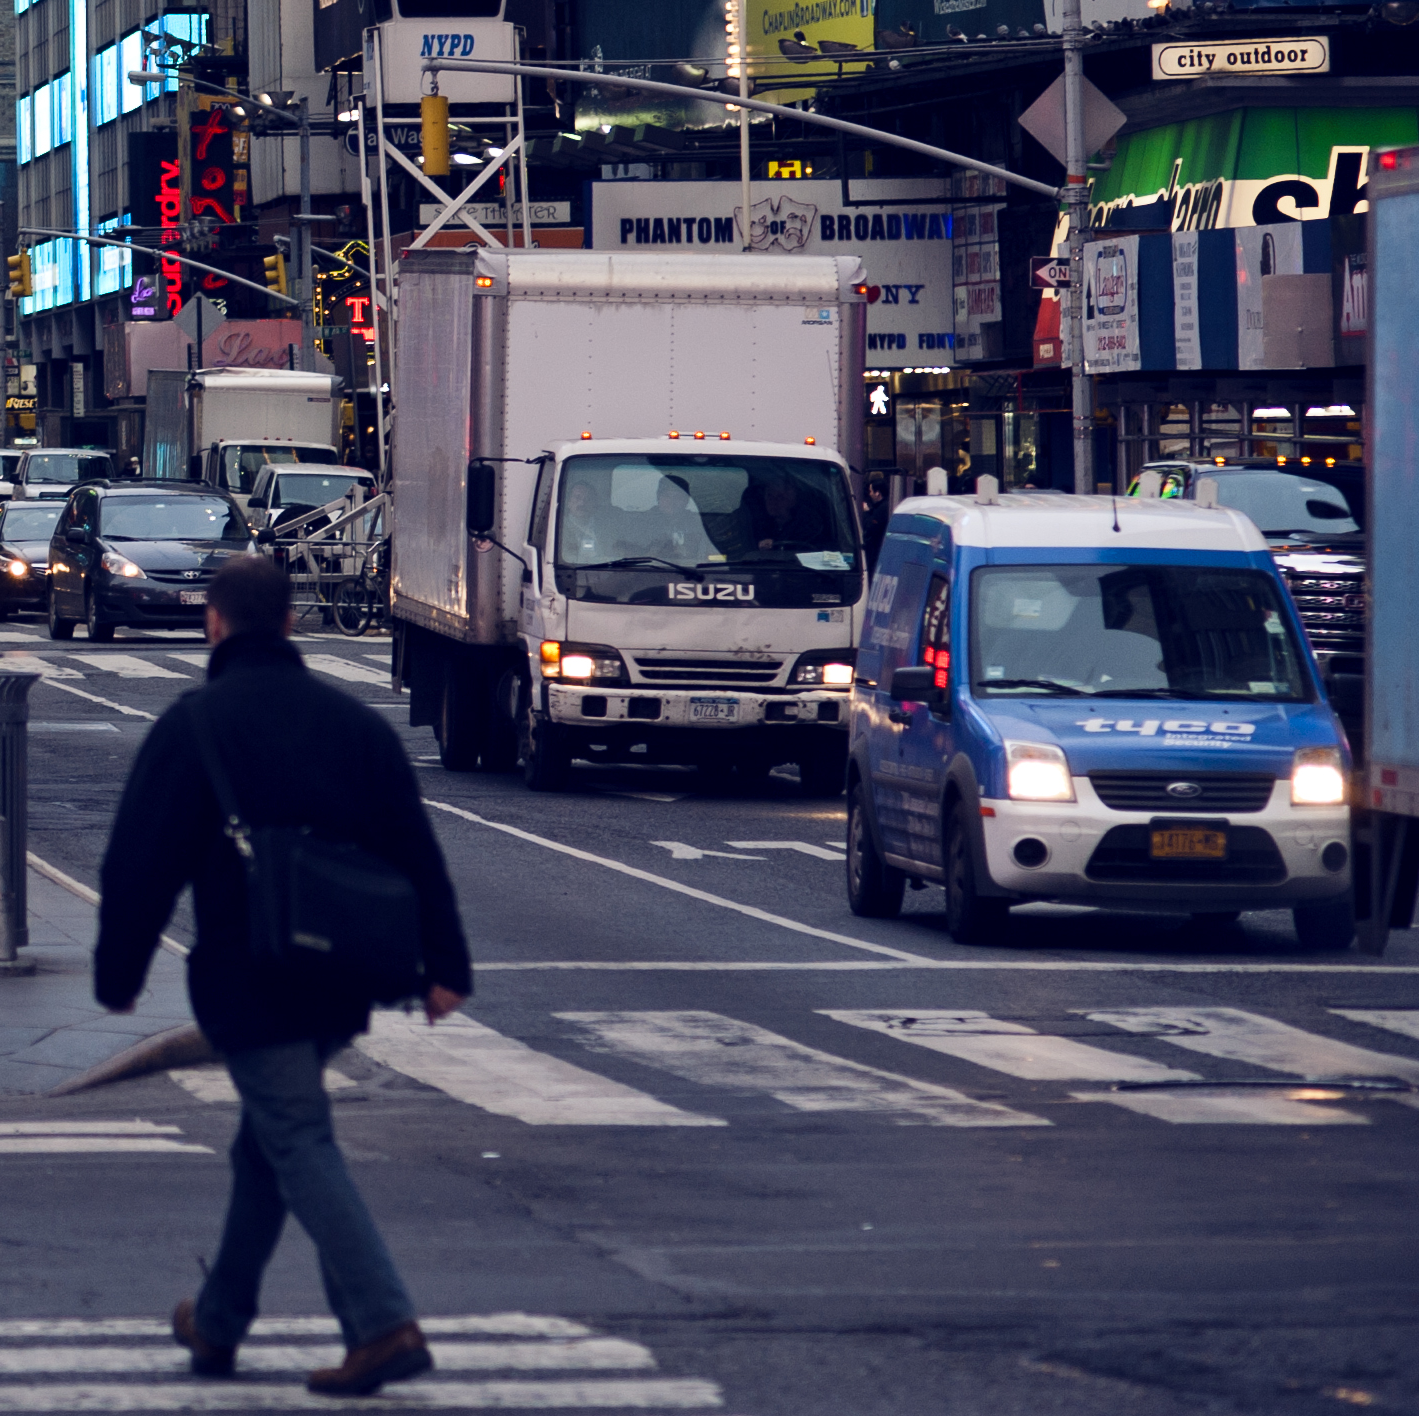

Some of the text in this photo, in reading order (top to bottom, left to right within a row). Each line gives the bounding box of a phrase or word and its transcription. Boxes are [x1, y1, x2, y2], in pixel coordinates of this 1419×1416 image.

[420, 33, 475, 57] NYPD
[1178, 45, 1309, 71] city outdoor
[620, 216, 734, 244] PHANTOM
[770, 220, 787, 236] OF
[820, 212, 954, 242] BROADWAY
[1048, 267, 1068, 279] ON
[881, 284, 925, 305] NY
[867, 333, 954, 350] NYPD FDNY
[668, 582, 755, 601] ISUZU
[1075, 718, 1256, 736] tyco
[1163, 739, 1233, 749] Security
[1165, 732, 1252, 742] Integrated
